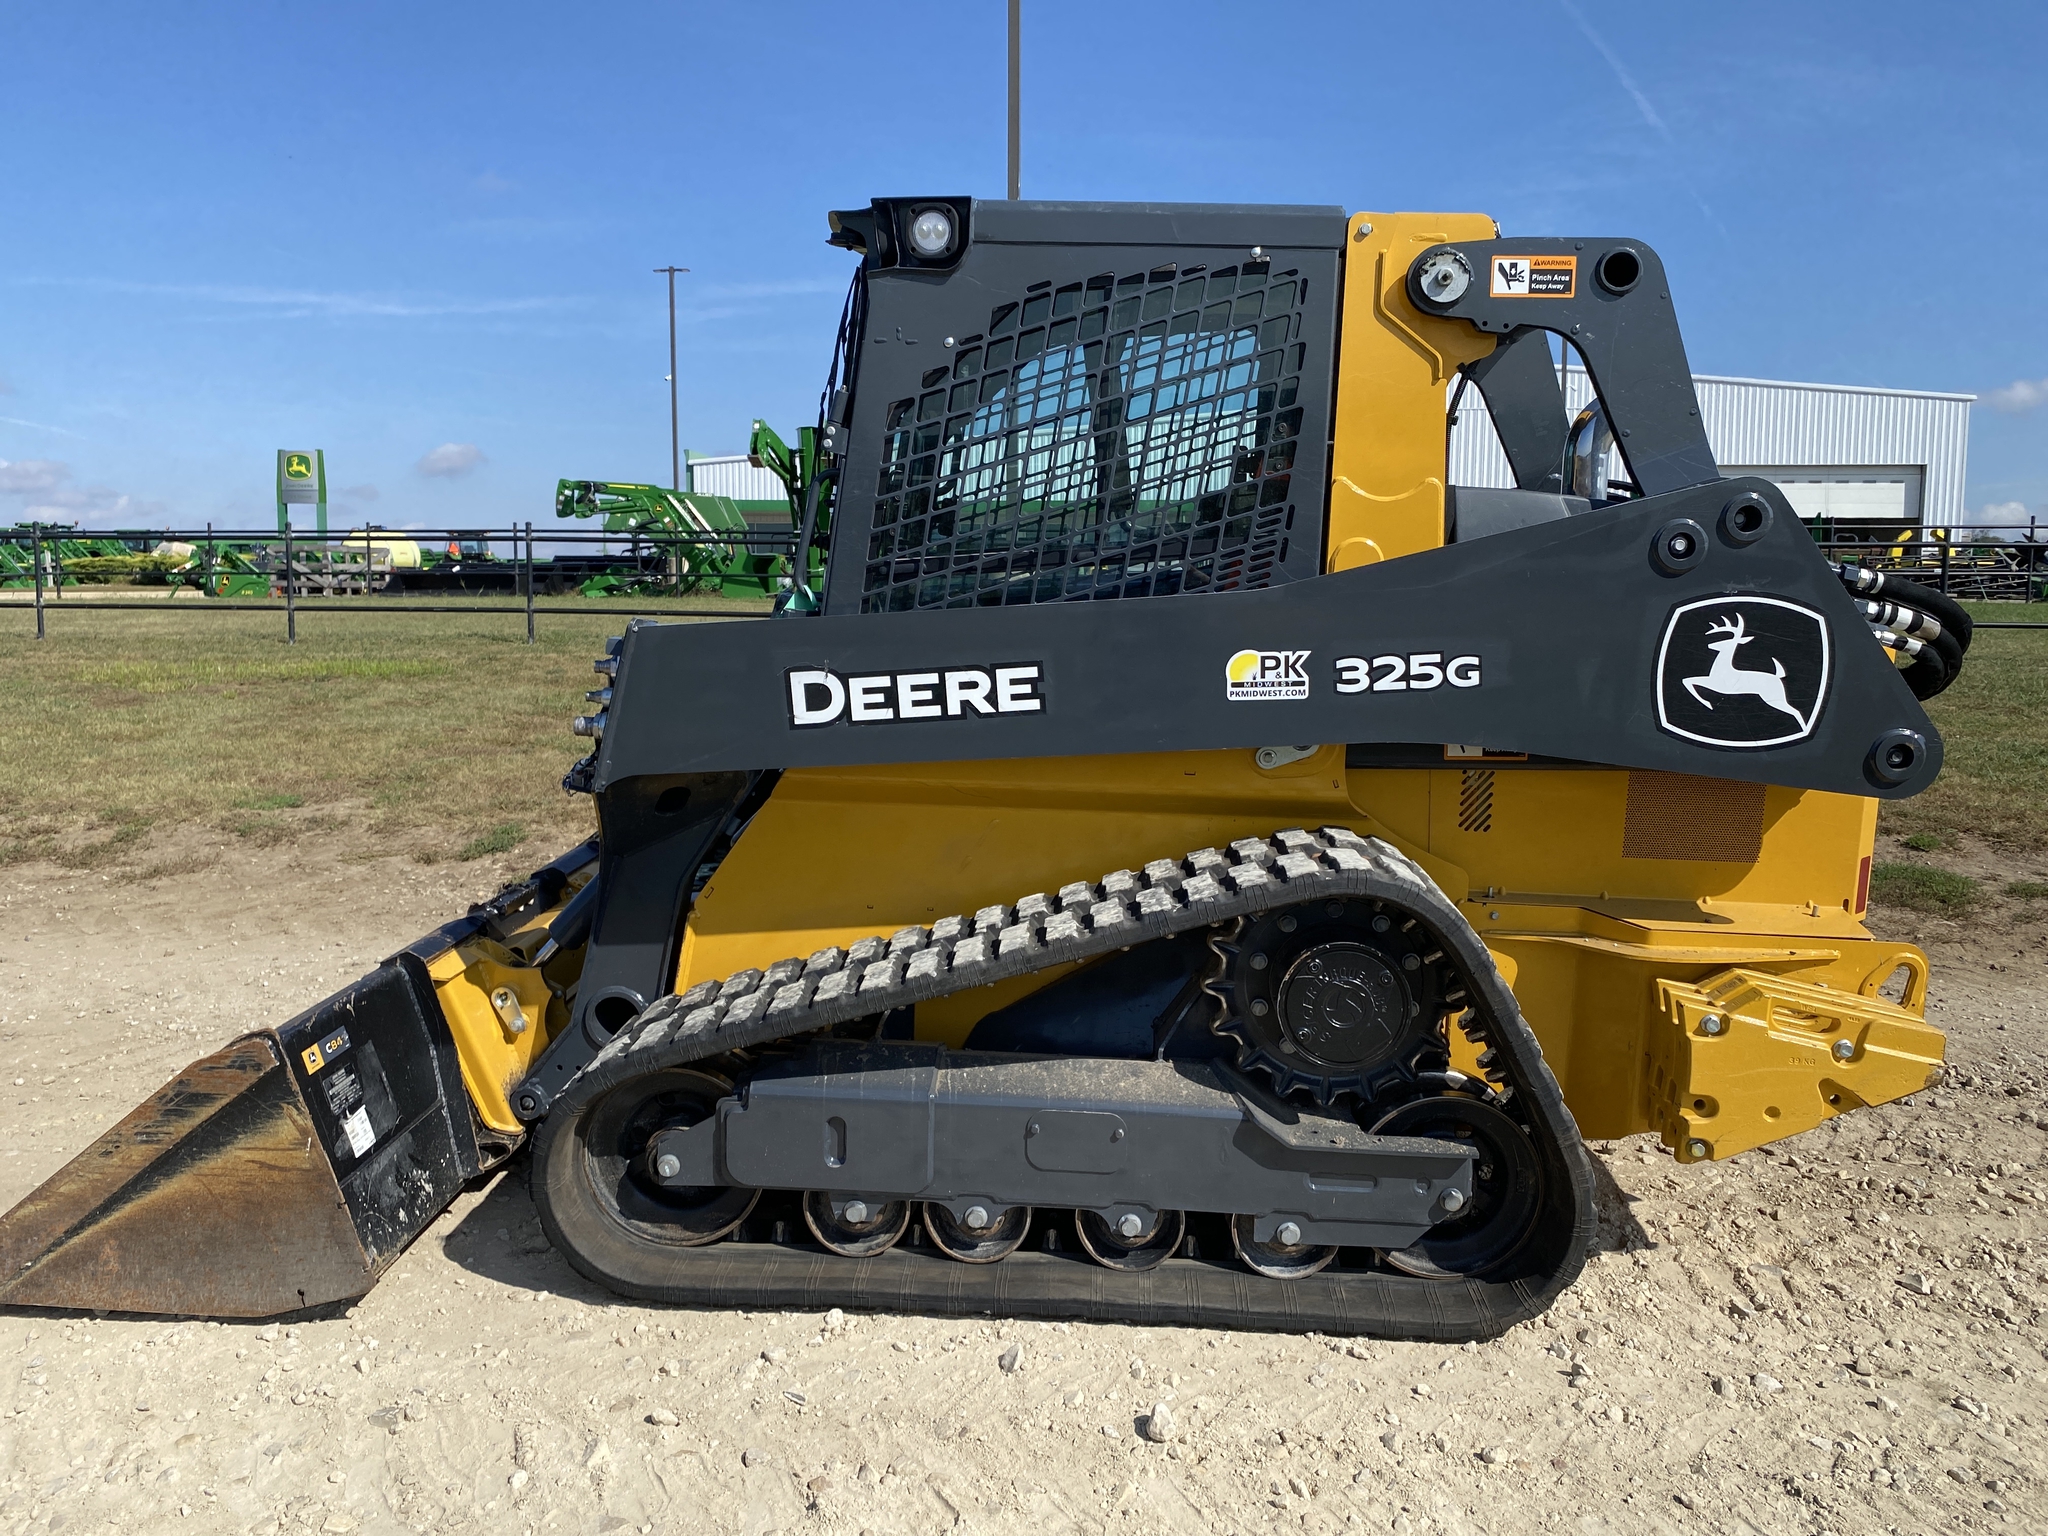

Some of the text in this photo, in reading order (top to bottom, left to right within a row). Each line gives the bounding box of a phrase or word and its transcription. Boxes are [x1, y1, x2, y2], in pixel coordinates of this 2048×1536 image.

[1540, 259, 1572, 267] WARNING
[1531, 273, 1570, 282] Pinch Area
[1531, 283, 1564, 291] Keep Away
[1335, 653, 1481, 693] 325G
[789, 665, 1042, 725] DEERE
[1229, 689, 1307, 698] PKMIDWEST.COM
[1803, 1057, 1816, 1066] KG
